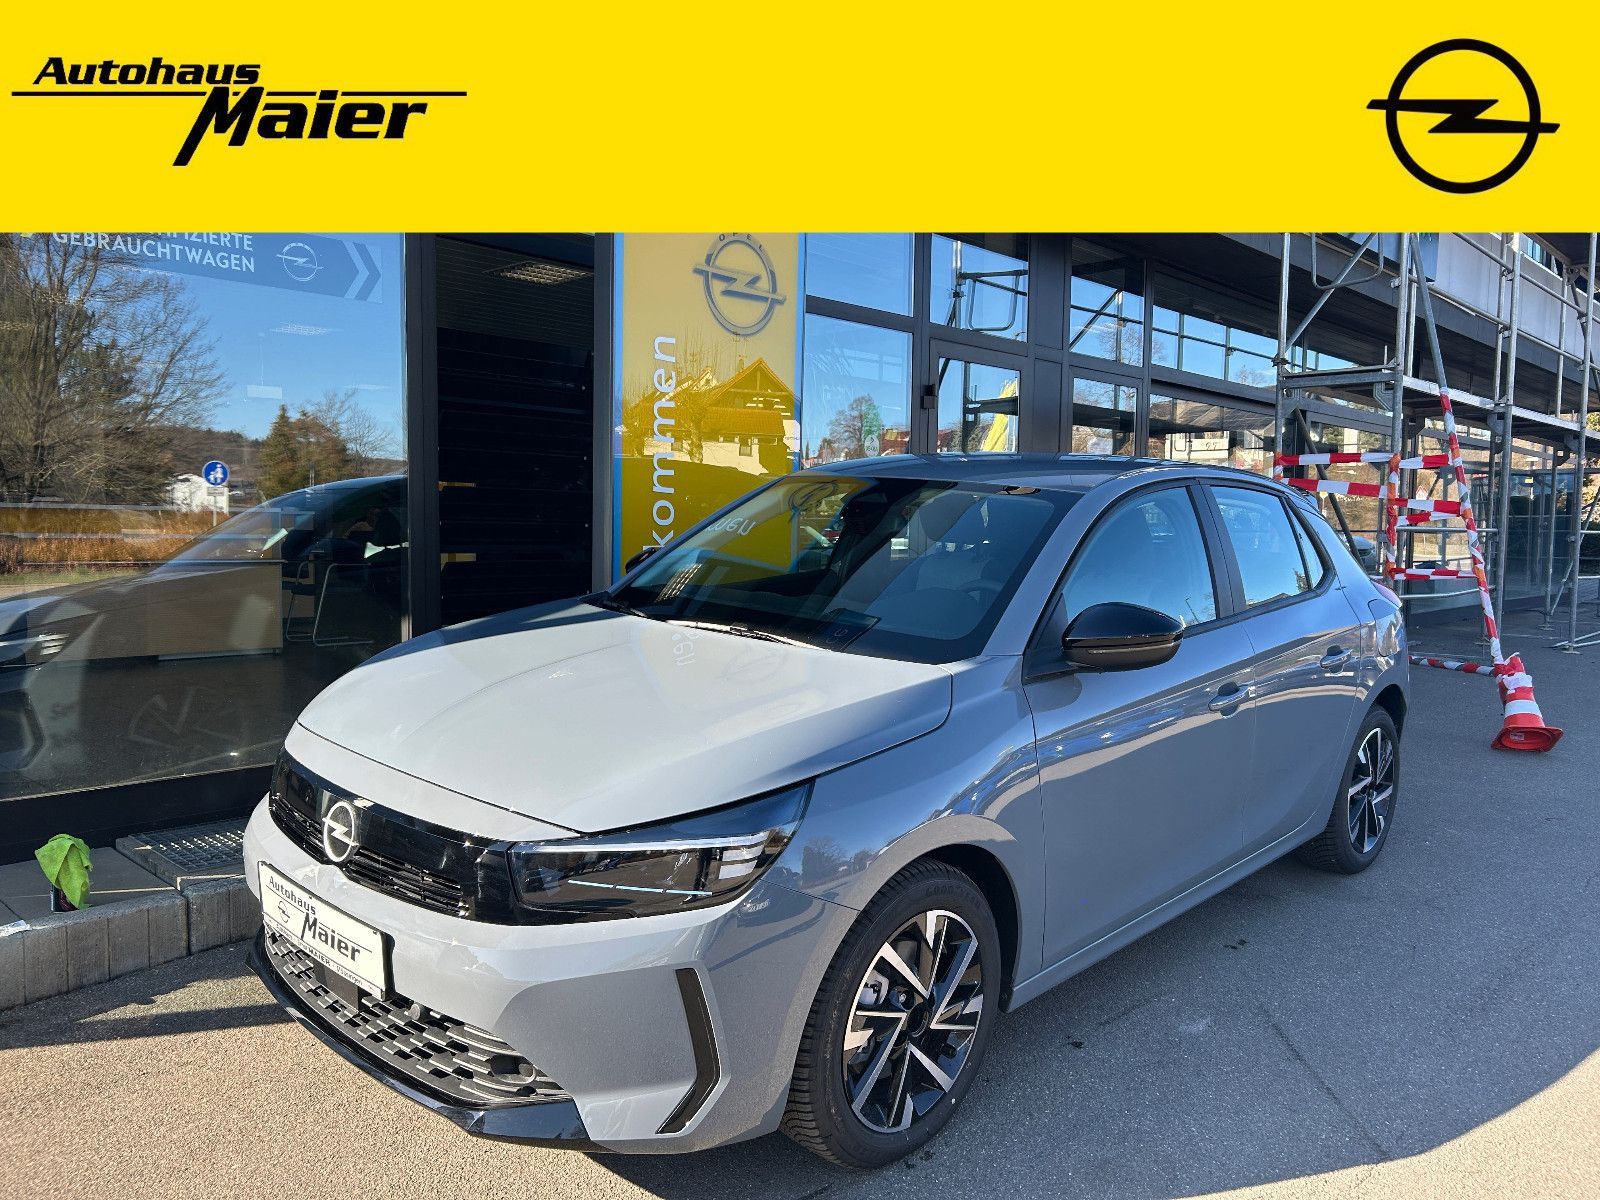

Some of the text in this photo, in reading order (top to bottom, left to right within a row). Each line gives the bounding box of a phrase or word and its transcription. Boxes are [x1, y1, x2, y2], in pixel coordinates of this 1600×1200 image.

[52, 232, 256, 273] GEBRAUCHTWAGEN
[269, 876, 316, 915] Autohaus
[301, 912, 361, 962] Maier
